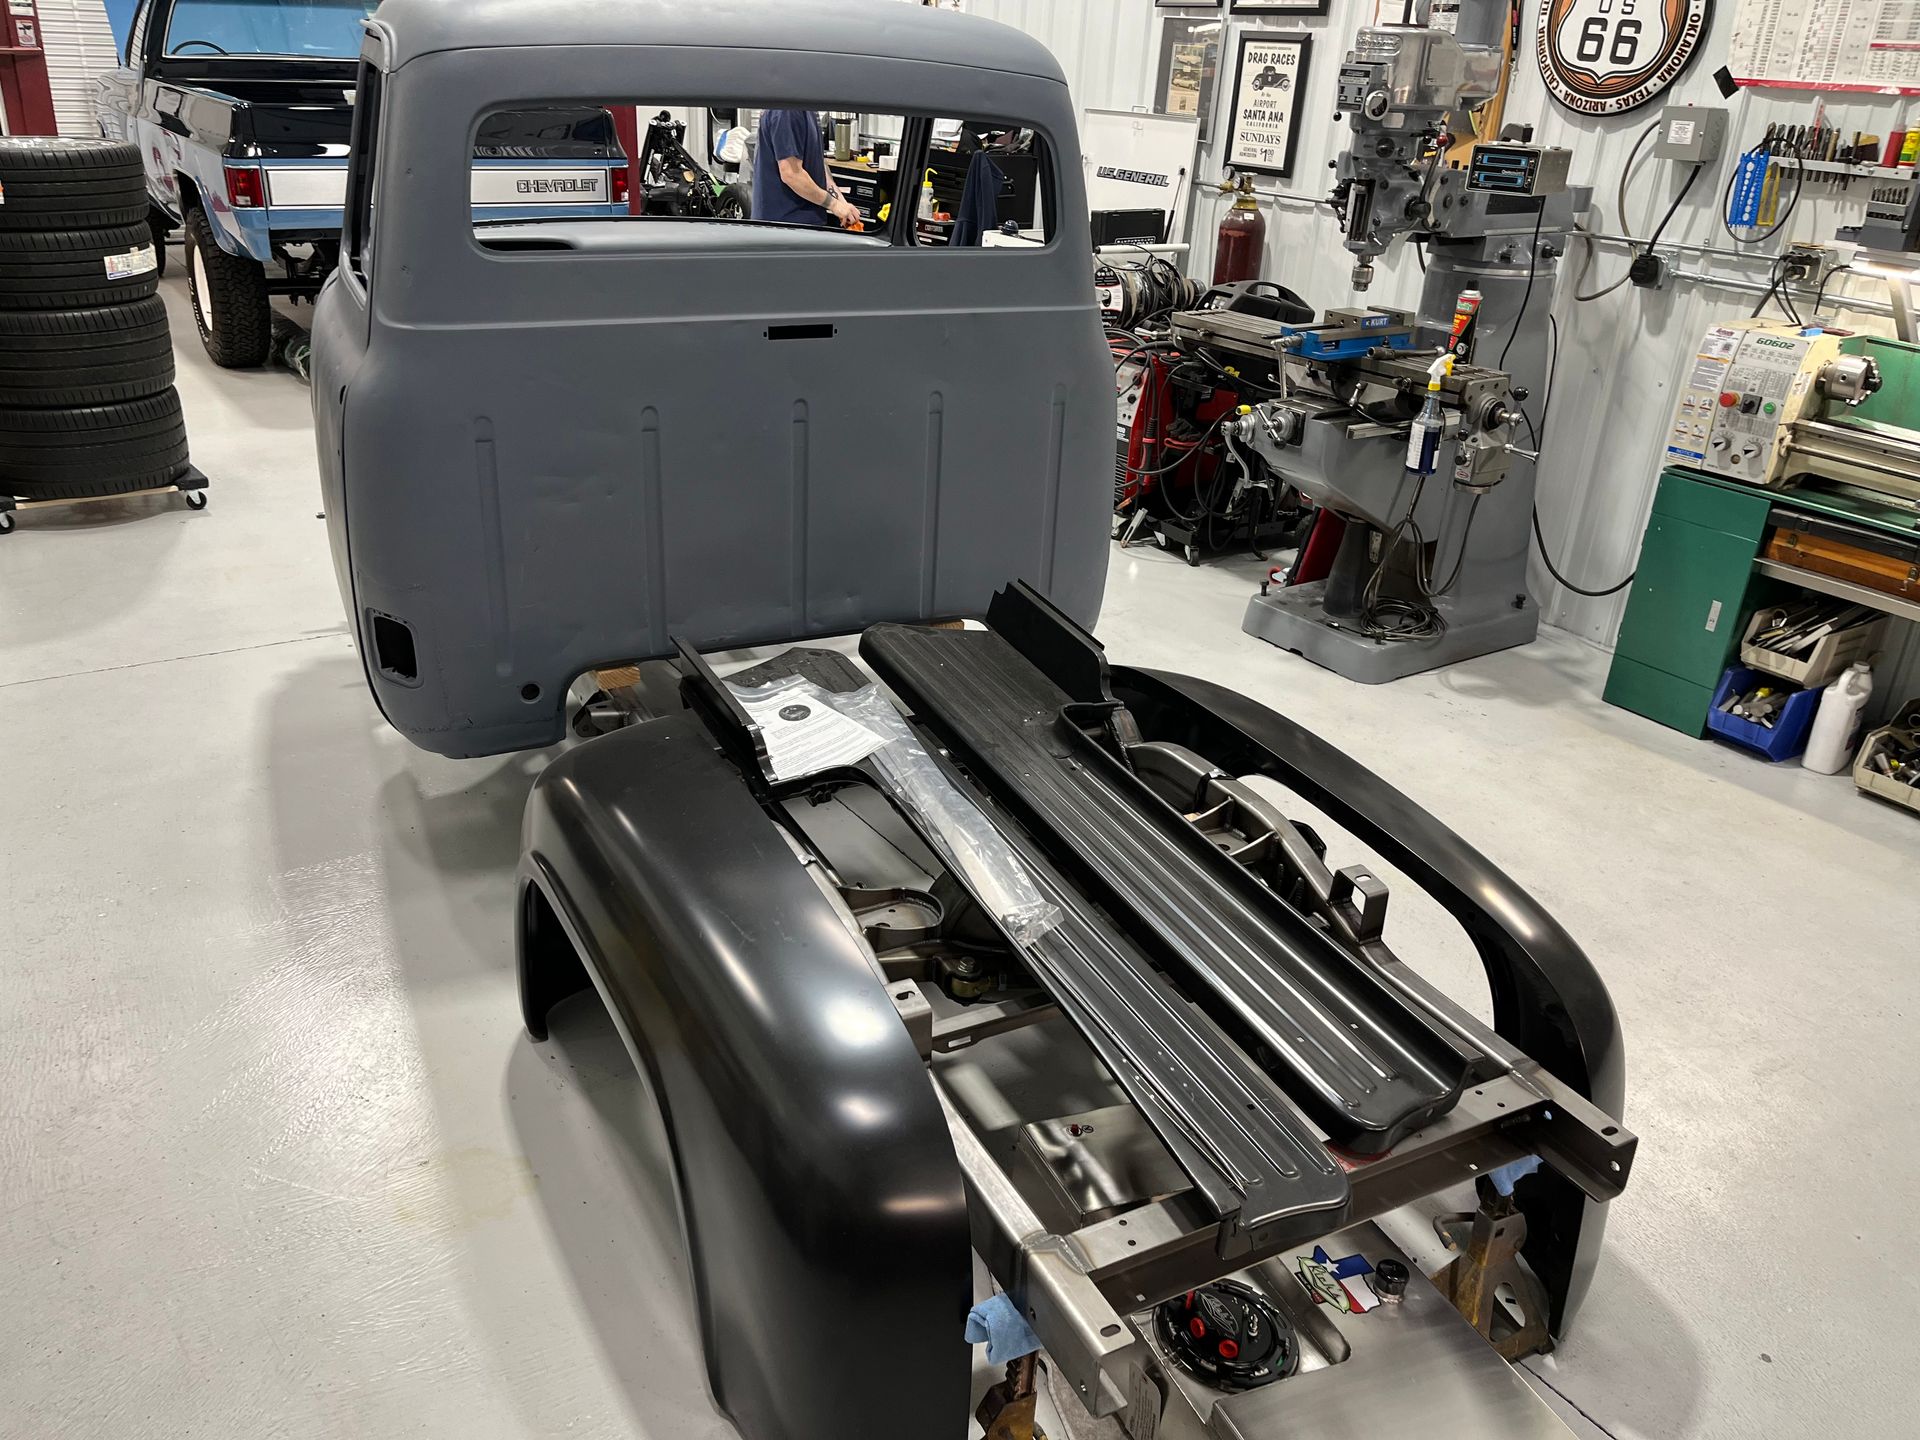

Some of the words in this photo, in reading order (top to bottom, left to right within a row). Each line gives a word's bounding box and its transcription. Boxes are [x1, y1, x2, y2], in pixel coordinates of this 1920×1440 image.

[1576, 17, 1642, 65] 66
[1656, 13, 1701, 83] OKLAHOMA
[1247, 52, 1268, 65] DRAG
[1271, 54, 1296, 66] RACES
[1537, 25, 1560, 88] CALIFORNIA
[1253, 99, 1277, 109] AIRPORT
[1563, 90, 1607, 112] ARIZONA
[1615, 84, 1653, 109] TEXAS
[1243, 109, 1266, 121] SANTA
[1268, 111, 1284, 123] ANA
[1239, 132, 1281, 145] SUNDAYS
[516, 179, 598, 193] CHEVROLET
[1116, 169, 1170, 187] GENERAL
[1370, 317, 1388, 327] KURT
